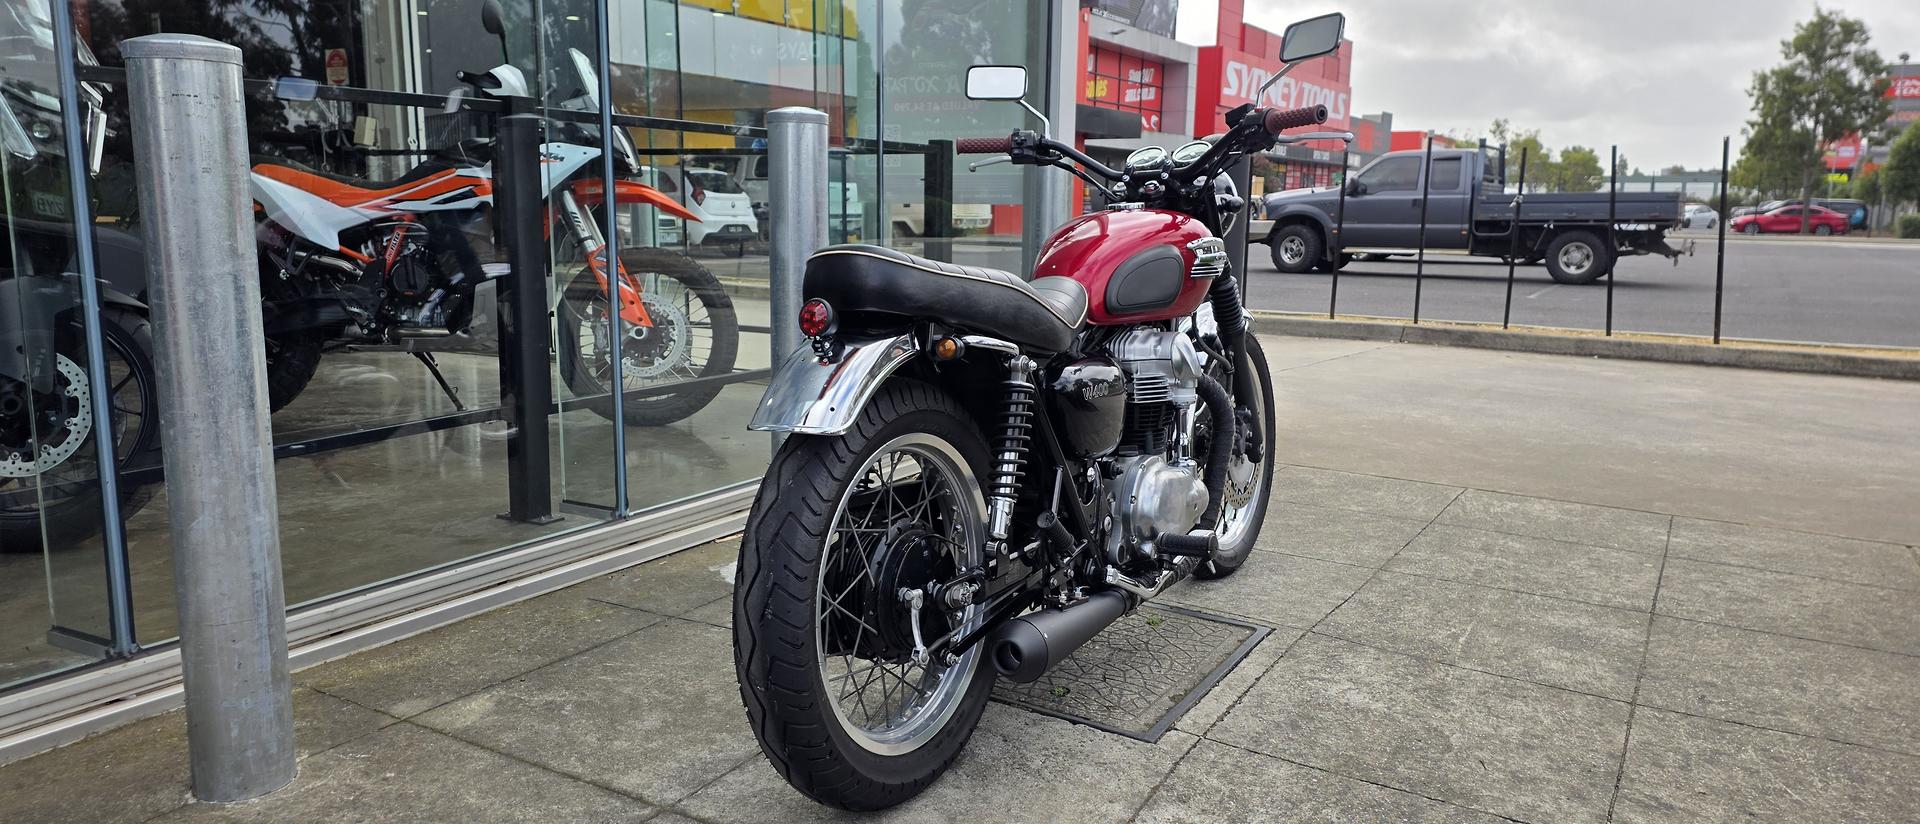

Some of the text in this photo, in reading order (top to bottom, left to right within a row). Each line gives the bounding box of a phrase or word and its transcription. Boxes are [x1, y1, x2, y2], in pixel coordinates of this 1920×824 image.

[1222, 60, 1348, 121] SYDNEY TOOLS
[1082, 382, 1108, 401] W400
